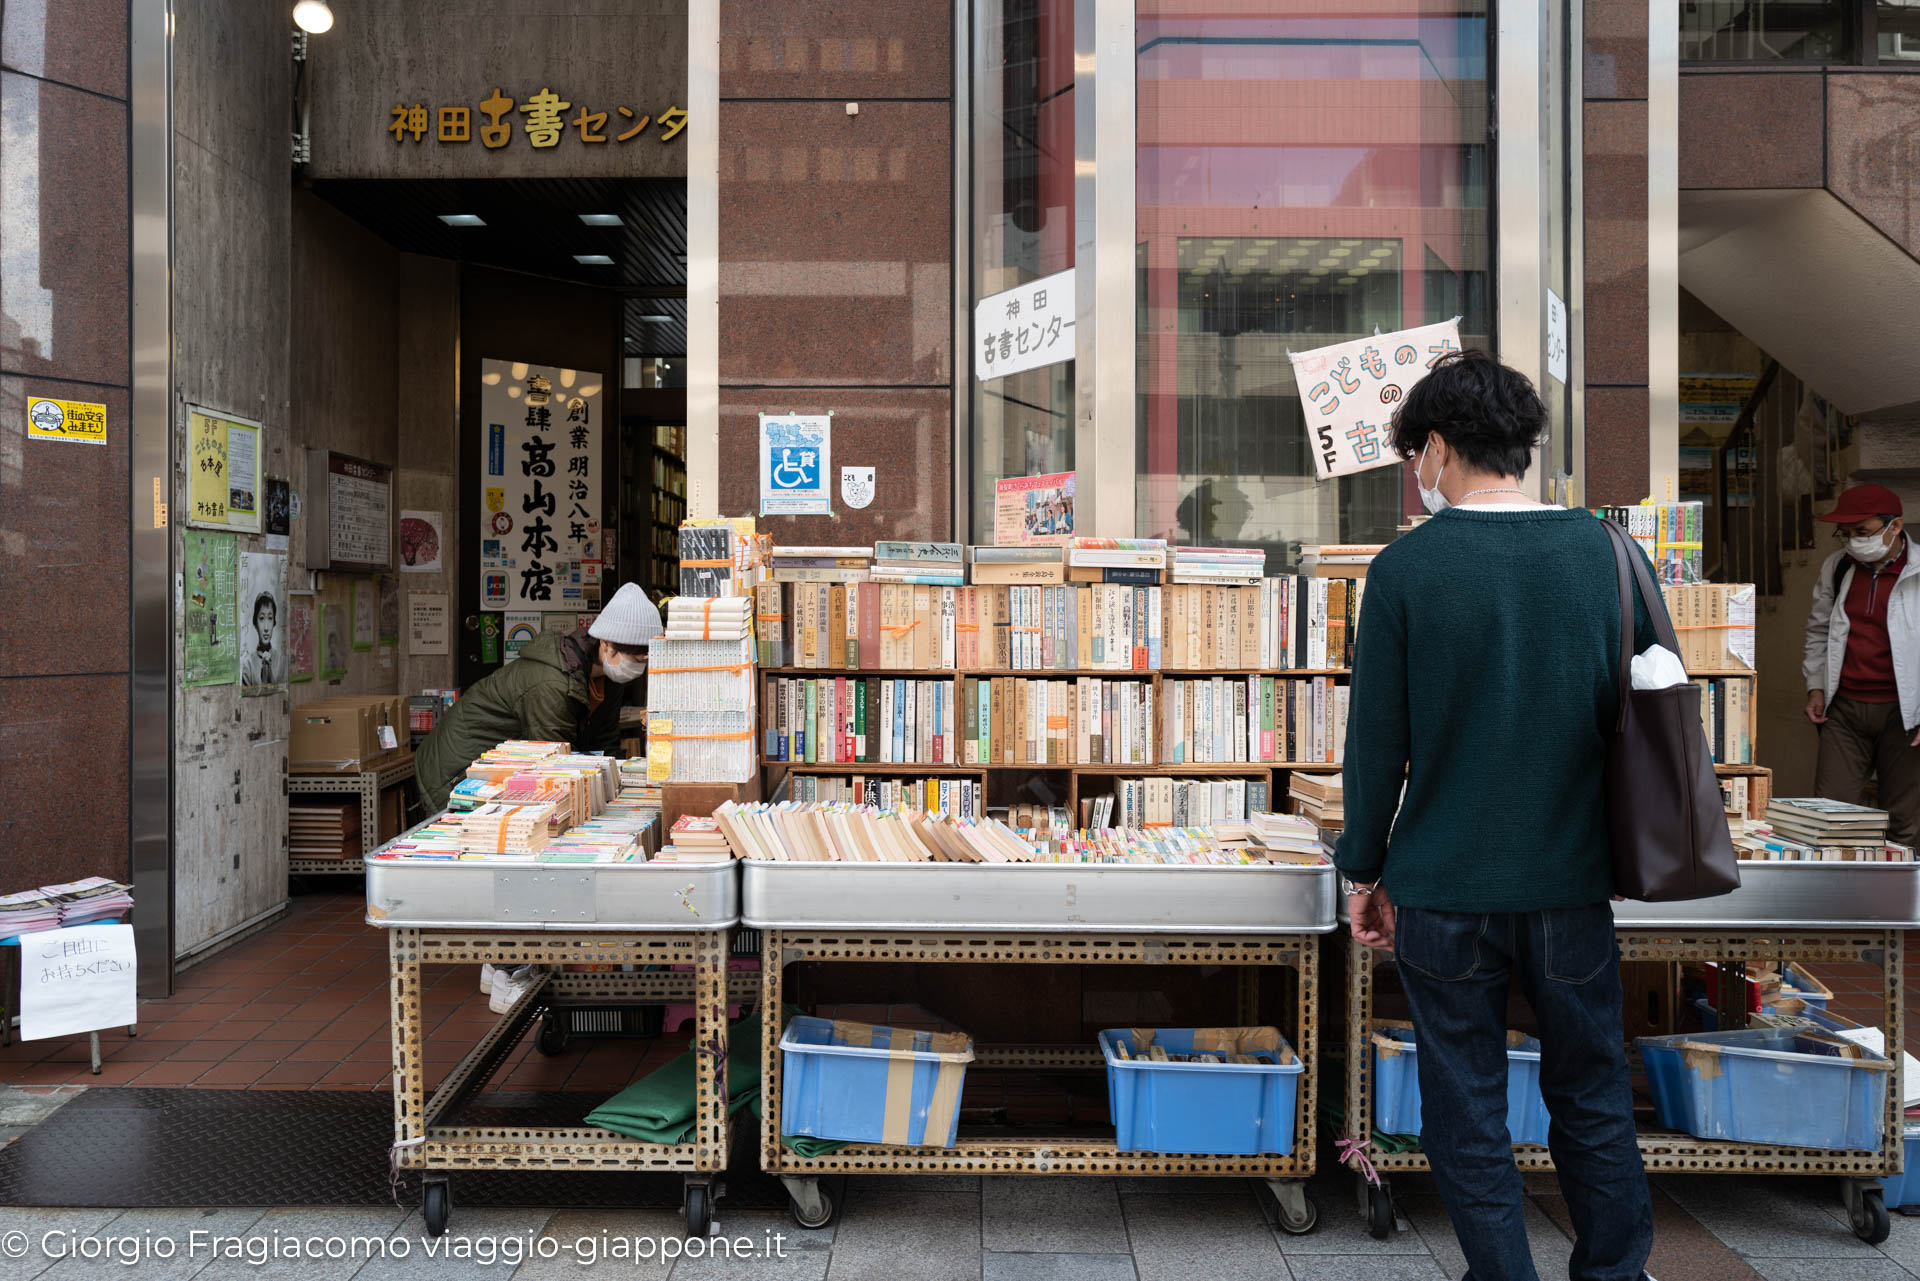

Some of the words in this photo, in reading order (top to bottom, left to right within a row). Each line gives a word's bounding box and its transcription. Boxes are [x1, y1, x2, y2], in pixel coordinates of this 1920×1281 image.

[389, 87, 688, 148] 神田古書センタ
[1006, 289, 1047, 320] 神田
[984, 315, 1076, 364] 古書センター
[67, 410, 104, 423] 街の安全
[67, 421, 104, 433] みまもり
[566, 399, 591, 543] 創業明治八年
[520, 436, 558, 601] 高山本店
[41, 938, 110, 959] ご自由に
[41, 959, 131, 984] お持ちください
